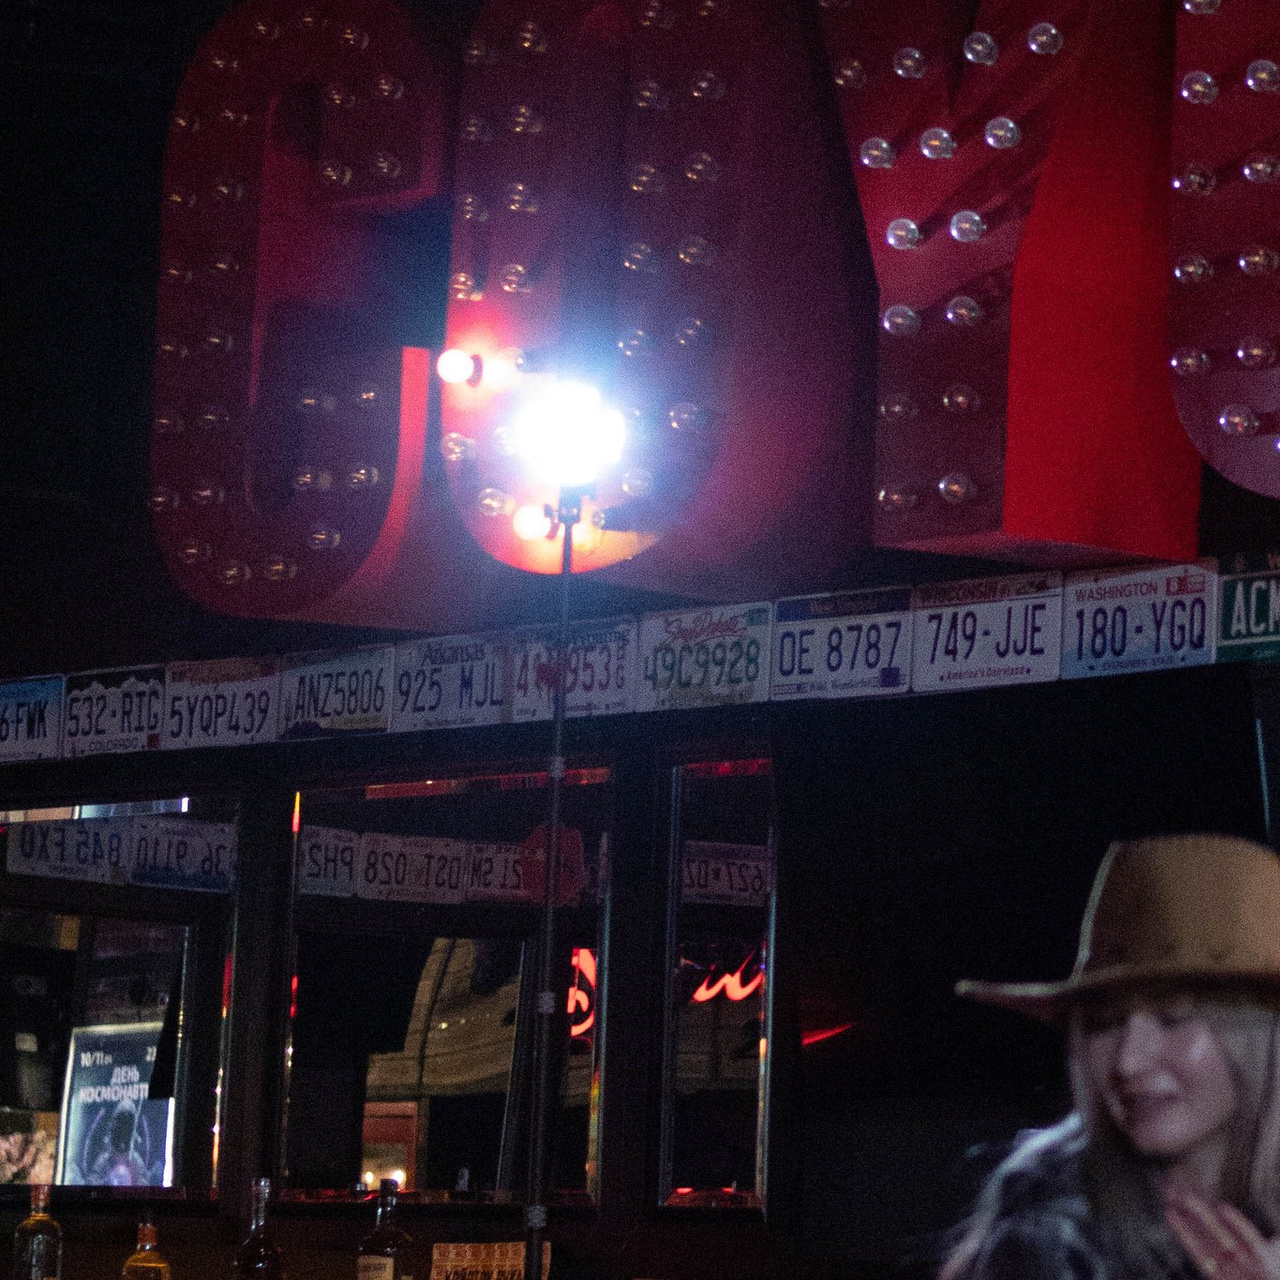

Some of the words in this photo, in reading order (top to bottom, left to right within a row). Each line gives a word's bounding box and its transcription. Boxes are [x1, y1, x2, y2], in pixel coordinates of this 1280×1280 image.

[1075, 582, 1158, 602] WASHINGTON
[421, 642, 485, 666] Arkansas
[826, 622, 902, 672] 8787
[928, 604, 1047, 665] 749-JJE
[295, 668, 385, 720] ANZ5806
[398, 668, 443, 713] 925
[459, 662, 504, 709] MJL
[169, 690, 271, 739] 5YQP439
